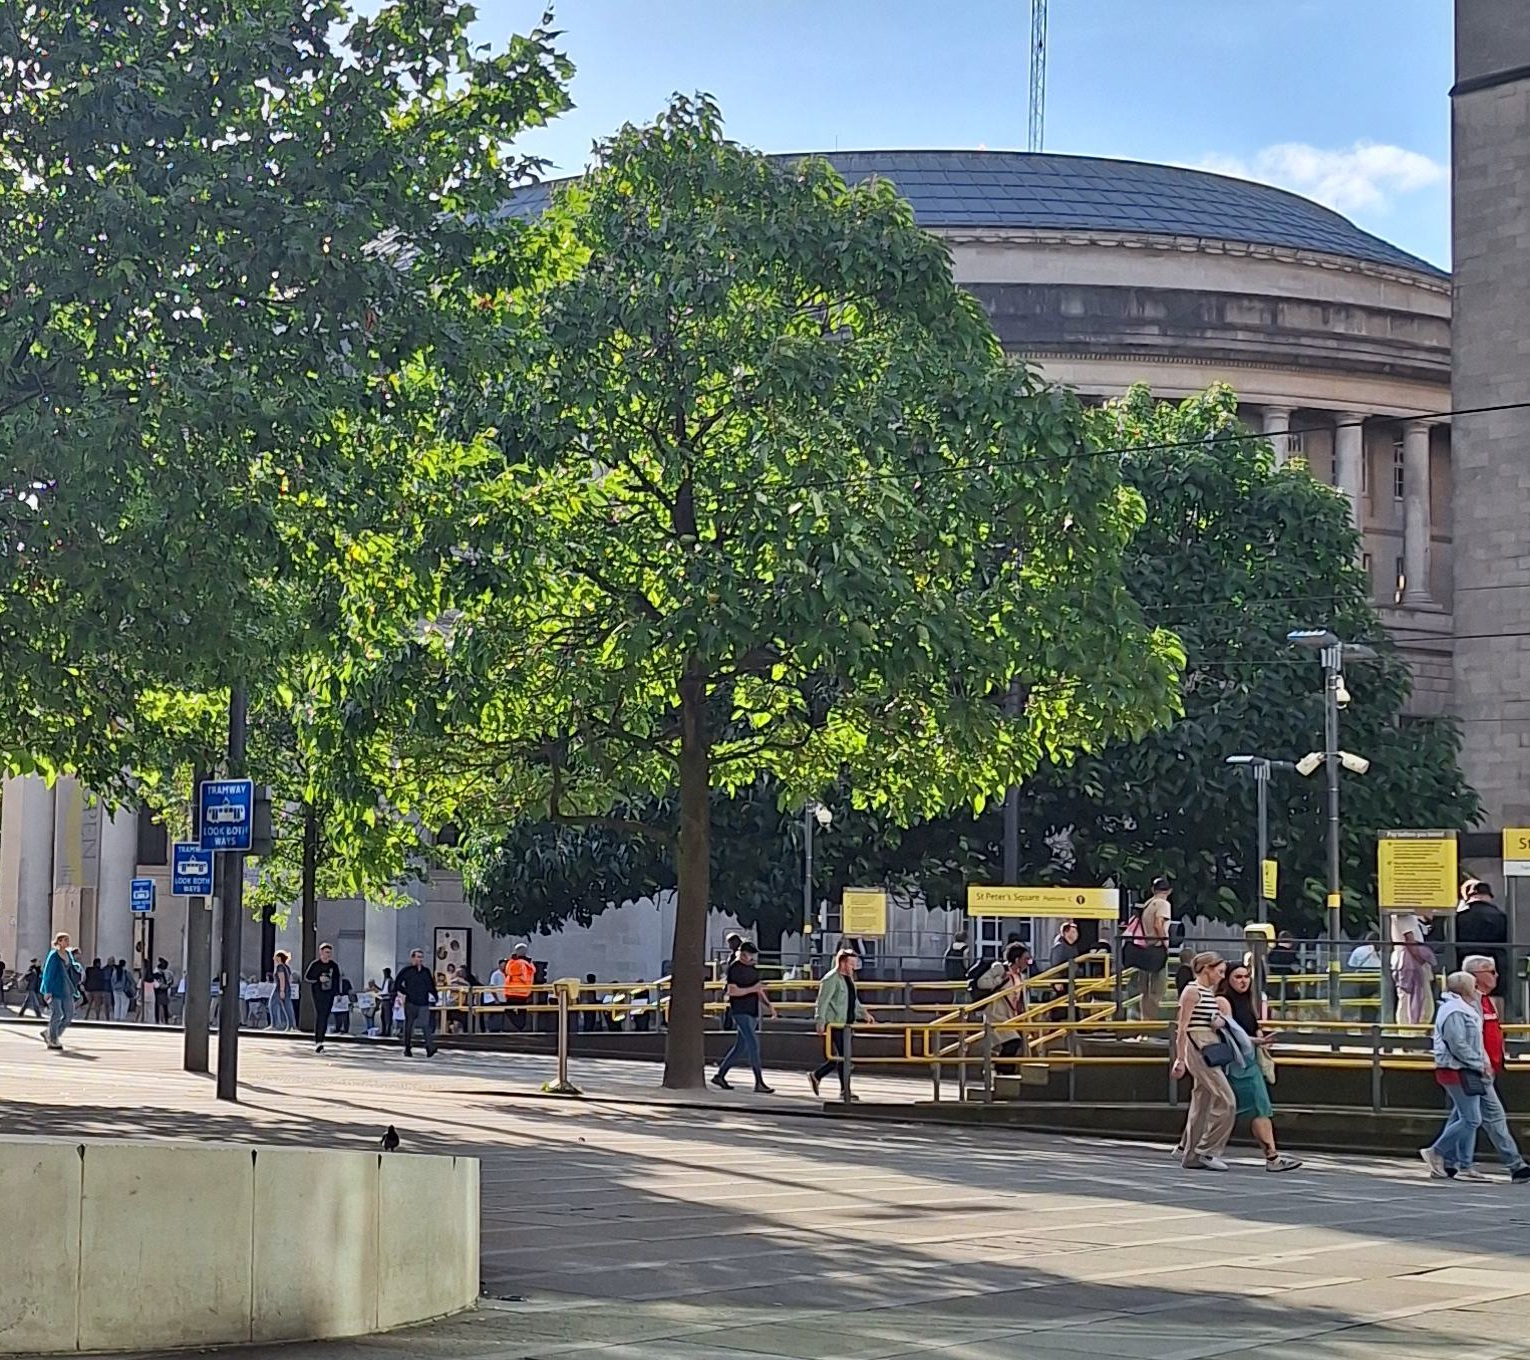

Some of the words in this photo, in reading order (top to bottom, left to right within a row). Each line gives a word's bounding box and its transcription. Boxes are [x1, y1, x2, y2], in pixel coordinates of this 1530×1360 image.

[207, 785, 247, 795] TRAMWAY
[203, 826, 225, 837] LOOK
[226, 826, 249, 836] BOTH
[214, 836, 237, 846] WAYS
[174, 877, 191, 885] LOOK
[192, 877, 211, 885] BOTH
[183, 885, 202, 893] WAYS
[976, 892, 984, 901] St
[985, 892, 1012, 902] Peter's
[1013, 893, 1040, 904] Square
